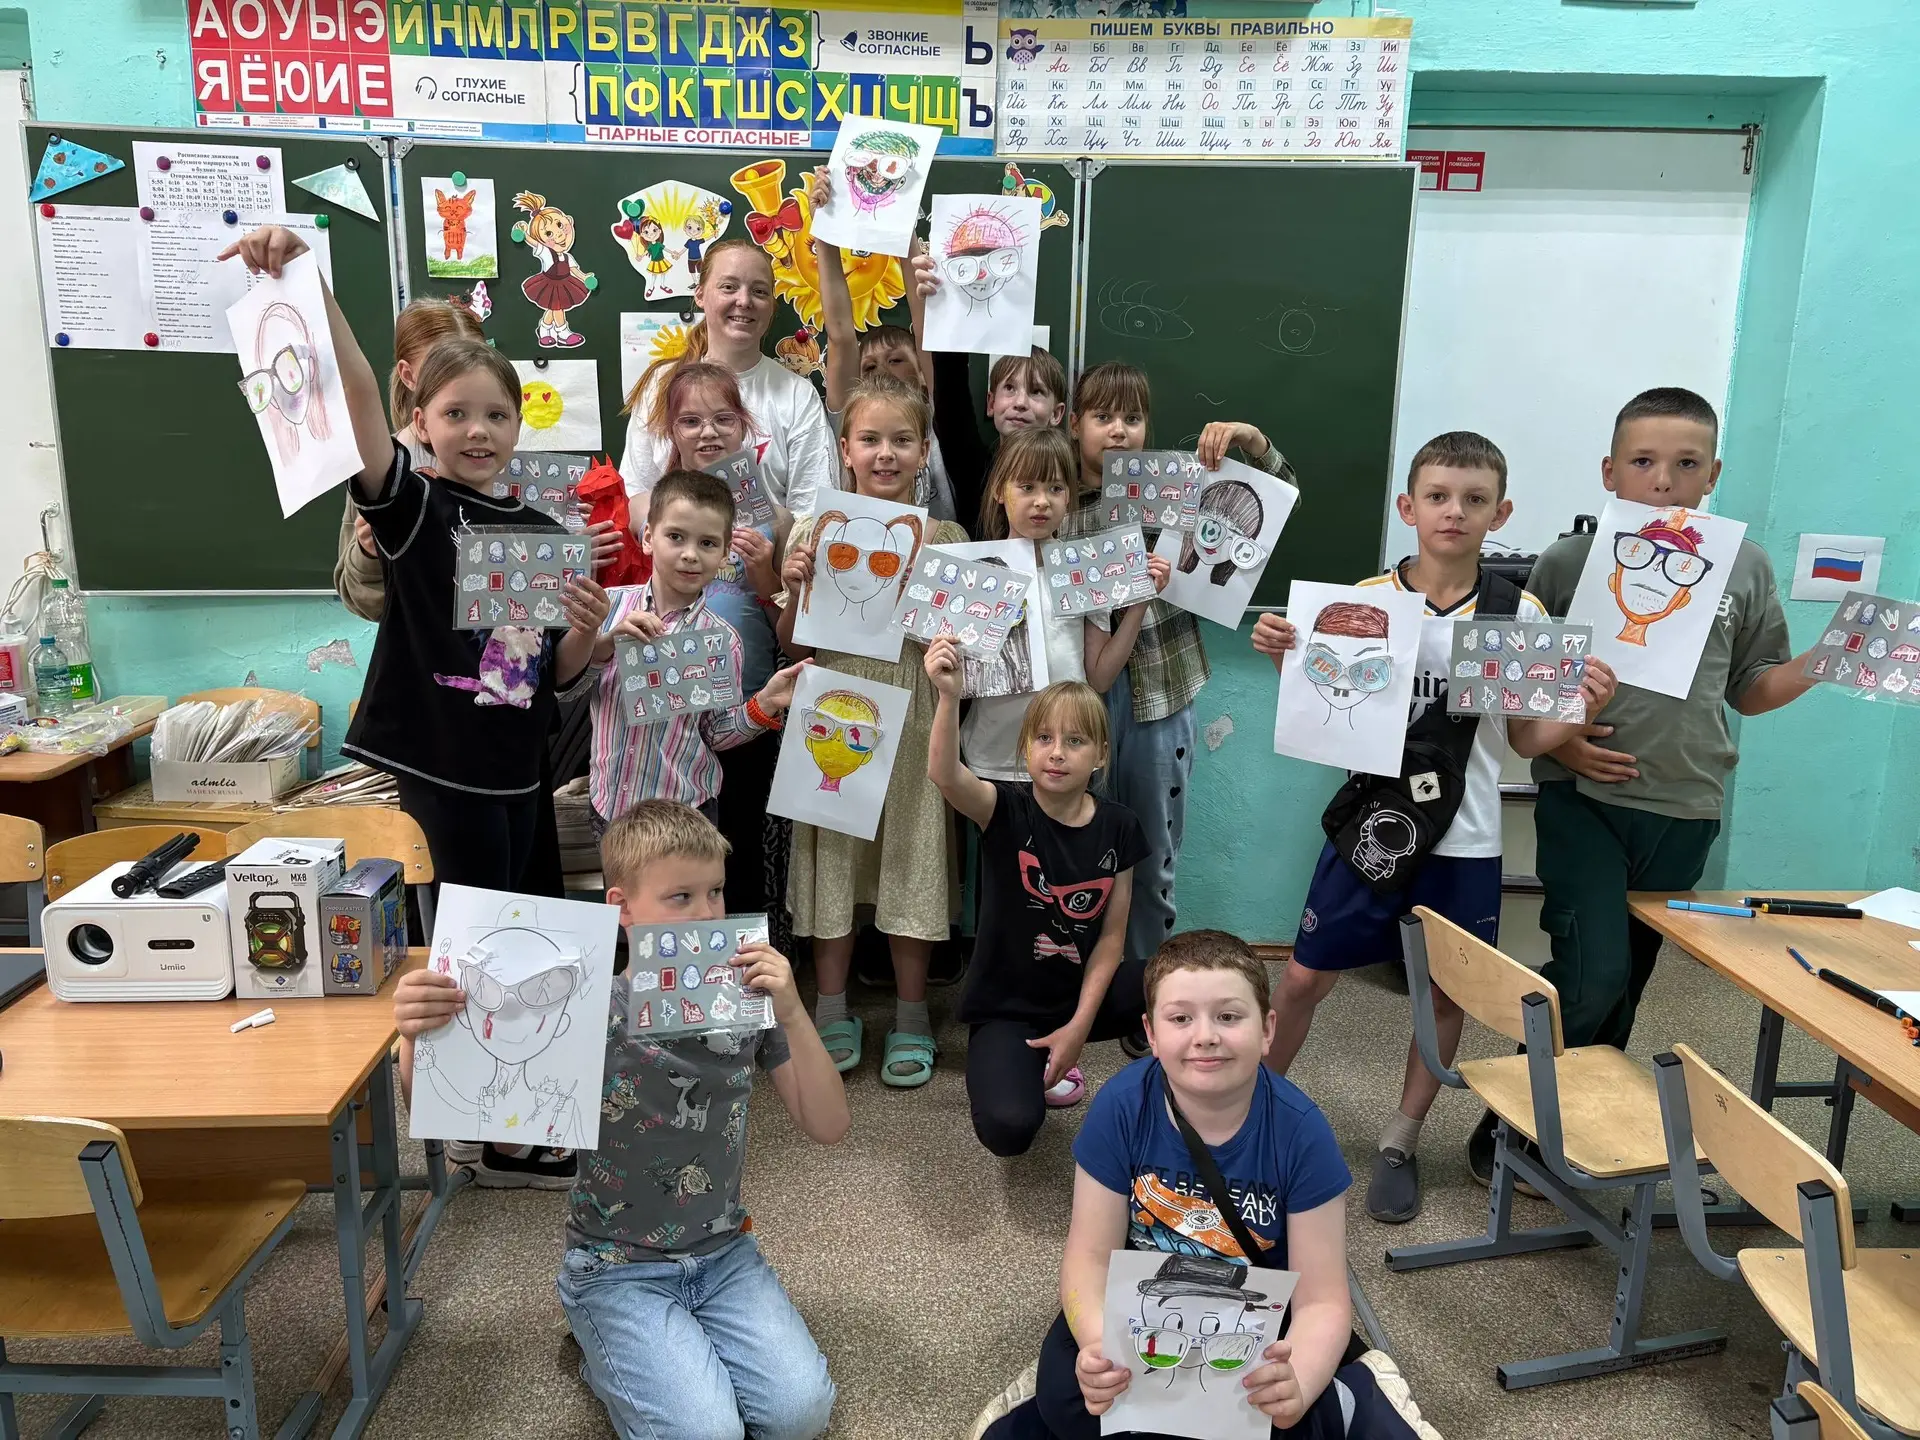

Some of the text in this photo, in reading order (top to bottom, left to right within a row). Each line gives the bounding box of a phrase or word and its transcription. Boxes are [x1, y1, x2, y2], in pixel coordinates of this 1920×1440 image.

[1090, 21, 1334, 36] ПИШЕМ БУКВЫ ПРАВИЛЬНО
[867, 30, 928, 42] ЗВОНКИЕ
[858, 43, 940, 56] СОГЛАСНЫЕ
[1054, 43, 1067, 52] Аа
[1094, 43, 1105, 52] Бб
[1132, 43, 1144, 51] Вв
[1206, 43, 1219, 52] Дд
[1242, 43, 1252, 51] Ее
[1310, 42, 1327, 50] Жж
[1351, 42, 1360, 50] Зз
[1384, 43, 1396, 51] Ии
[456, 77, 507, 90] ГЛУХИЕ
[1011, 80, 1024, 89] Йй
[1052, 81, 1063, 89] Кк
[1089, 81, 1102, 89] Лл
[1126, 81, 1143, 89] Мм
[1205, 81, 1217, 89] Оо
[1240, 81, 1252, 89] Пп
[1277, 81, 1289, 91] Рр
[1311, 81, 1322, 89] Сс
[1345, 81, 1355, 89] Тт
[1381, 81, 1392, 92] Уу
[441, 91, 526, 105] СОГЛАСНЫЕ
[1010, 117, 1025, 127] Фф
[1051, 117, 1062, 125] Хх
[1089, 117, 1102, 127] Цц
[1161, 118, 1179, 127] Шш
[1205, 118, 1223, 128] Щщ
[1308, 118, 1319, 127] Ээ
[1340, 119, 1357, 127] Юю
[1378, 119, 1389, 127] Яя
[600, 126, 800, 146] ПАРНЫЕ СОГЛАСНЫЕ
[191, 778, 237, 787] admlis
